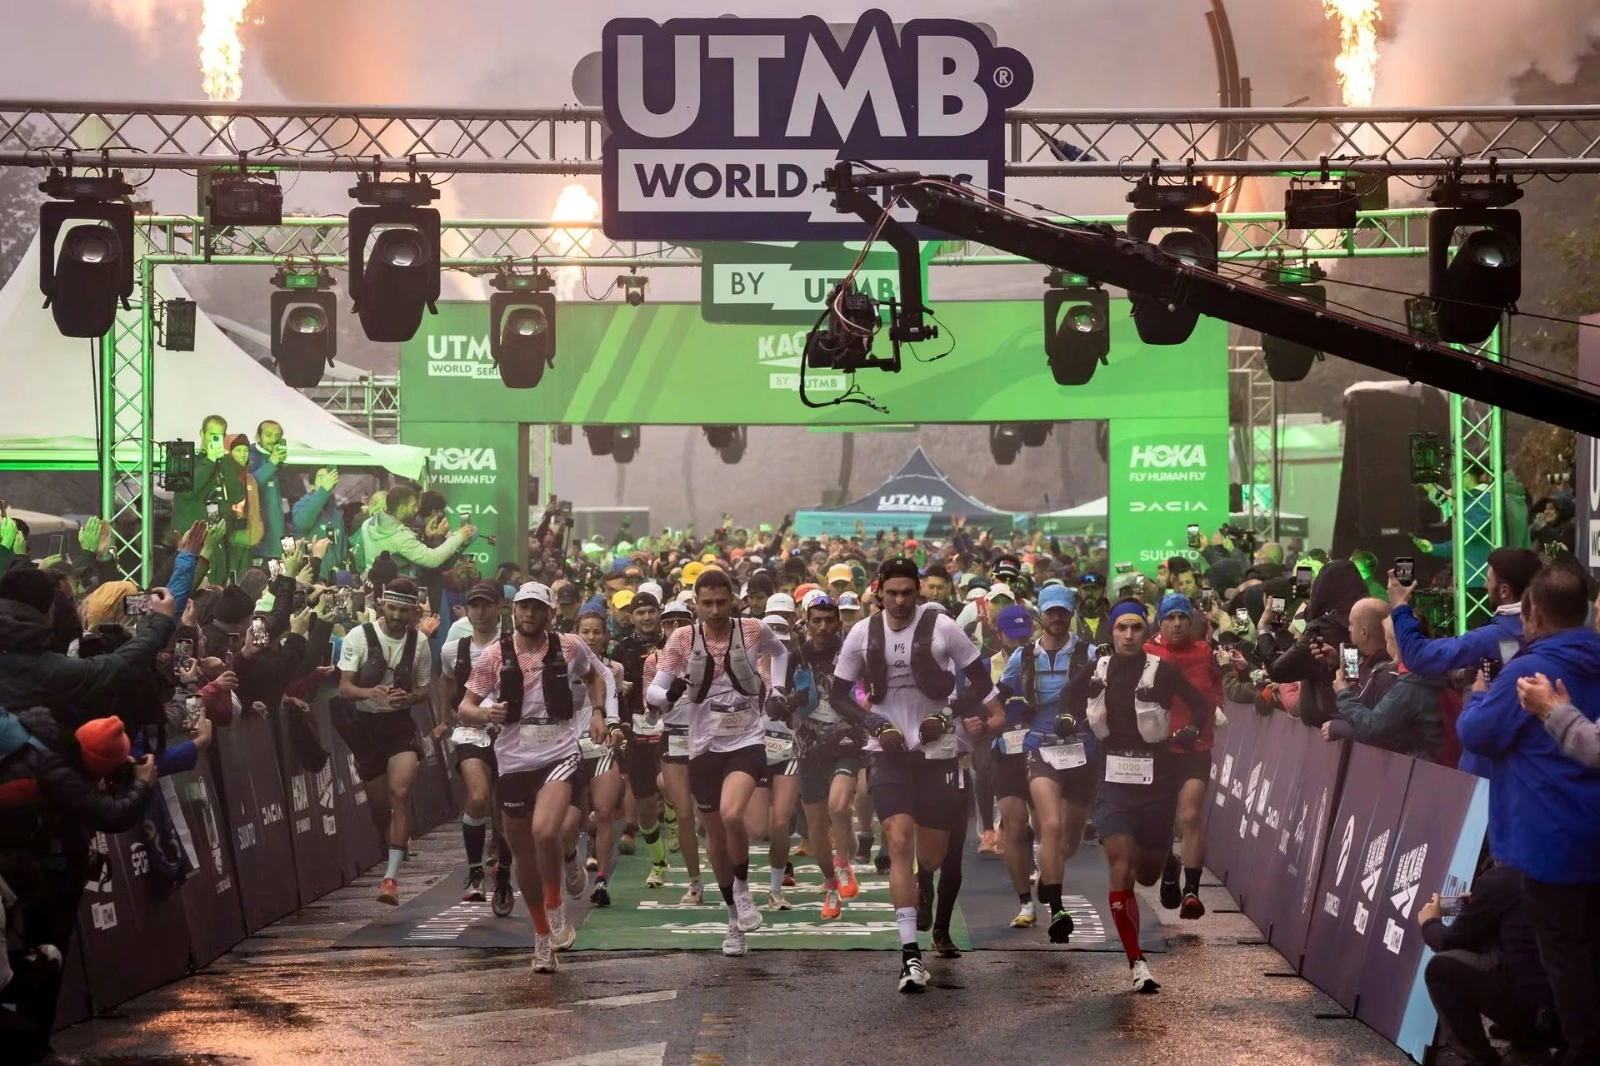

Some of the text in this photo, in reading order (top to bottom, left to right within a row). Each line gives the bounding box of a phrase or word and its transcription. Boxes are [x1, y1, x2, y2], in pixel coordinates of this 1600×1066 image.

[617, 26, 989, 143] UTMB
[634, 163, 808, 199] WORLD
[731, 272, 765, 294] BY
[427, 333, 496, 360] UTM
[432, 364, 500, 376] WORLD SERI
[776, 376, 790, 386] BY
[1129, 445, 1207, 468] HOKA
[439, 474, 478, 484] HUMAN
[480, 475, 496, 484] FLY
[1129, 472, 1206, 482] FLY HUMAN FLY
[879, 494, 944, 506] UTMB
[445, 504, 499, 515] ACIA
[1129, 501, 1208, 512] DACIA
[1140, 549, 1199, 561] SUUNTO
[1117, 762, 1141, 772] 1020
